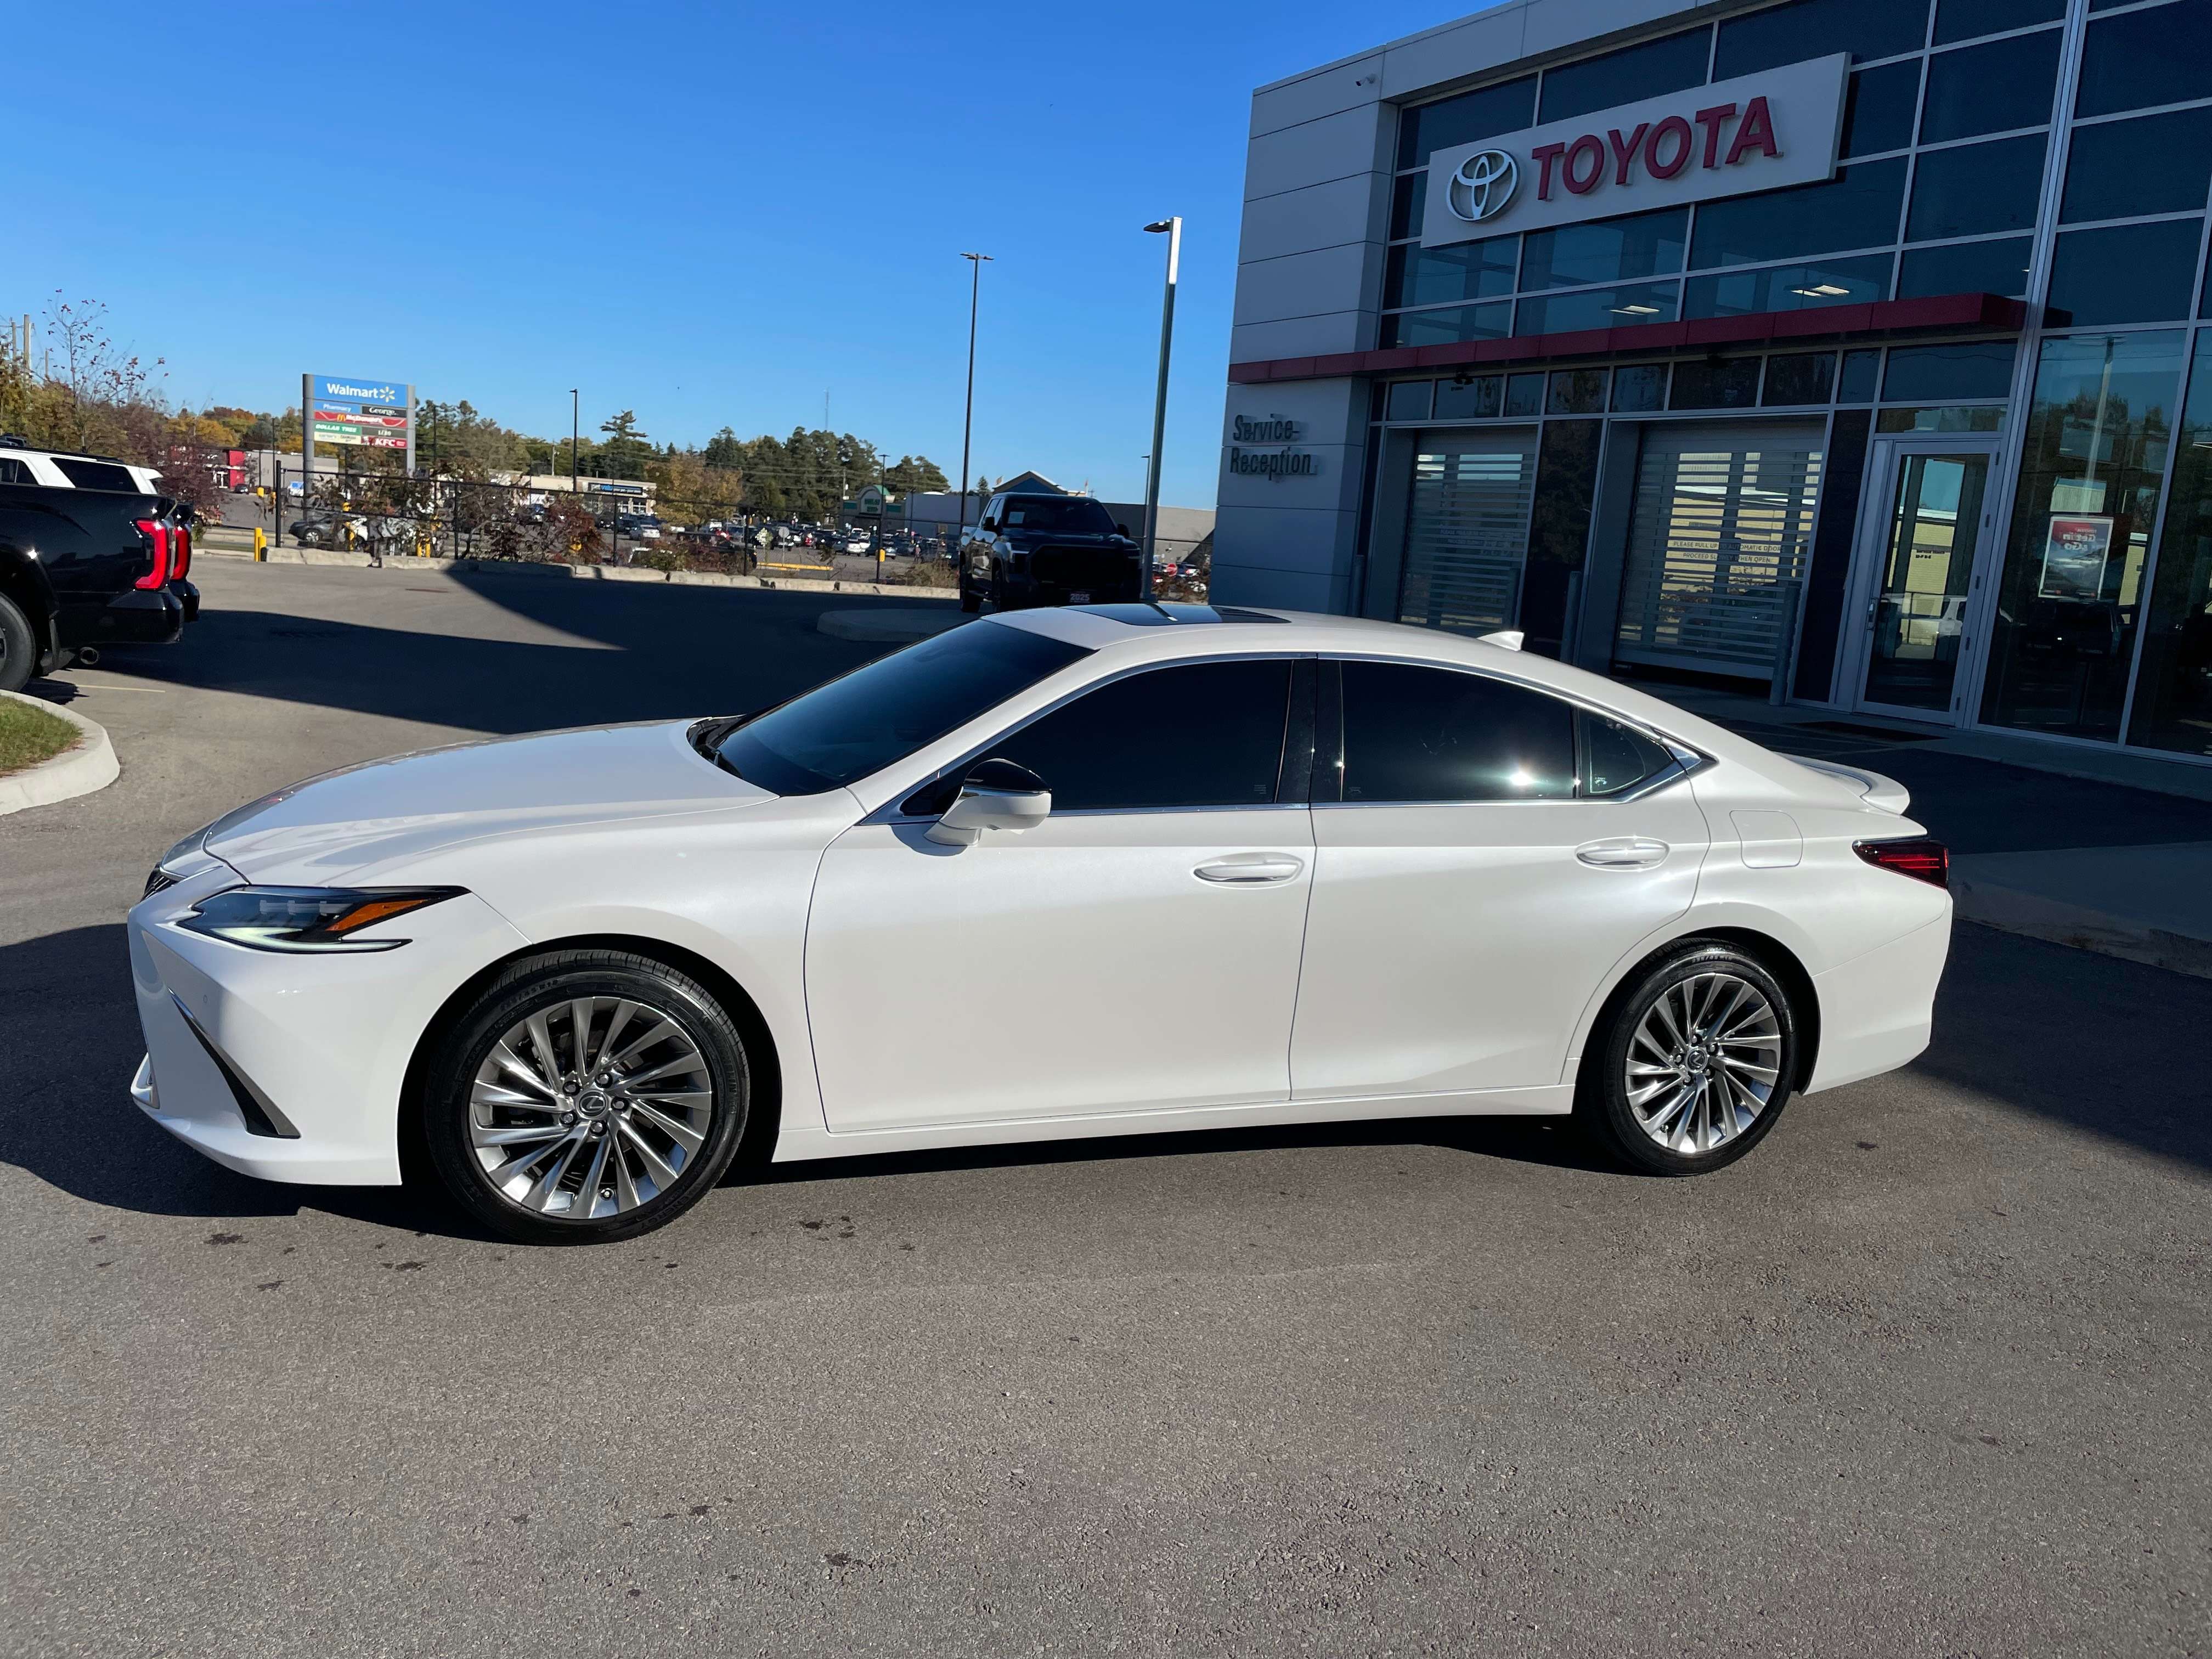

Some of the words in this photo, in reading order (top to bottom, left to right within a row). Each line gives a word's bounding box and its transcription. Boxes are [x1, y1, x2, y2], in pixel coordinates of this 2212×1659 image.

[1532, 96, 1779, 201] TOYOTA
[327, 383, 379, 399] Walmart
[1233, 413, 1294, 441] Service
[375, 438, 396, 447] KFC
[1230, 447, 1311, 481] Reception
[1070, 593, 1091, 601] 2025
[641, 1196, 690, 1229] ENERGY
